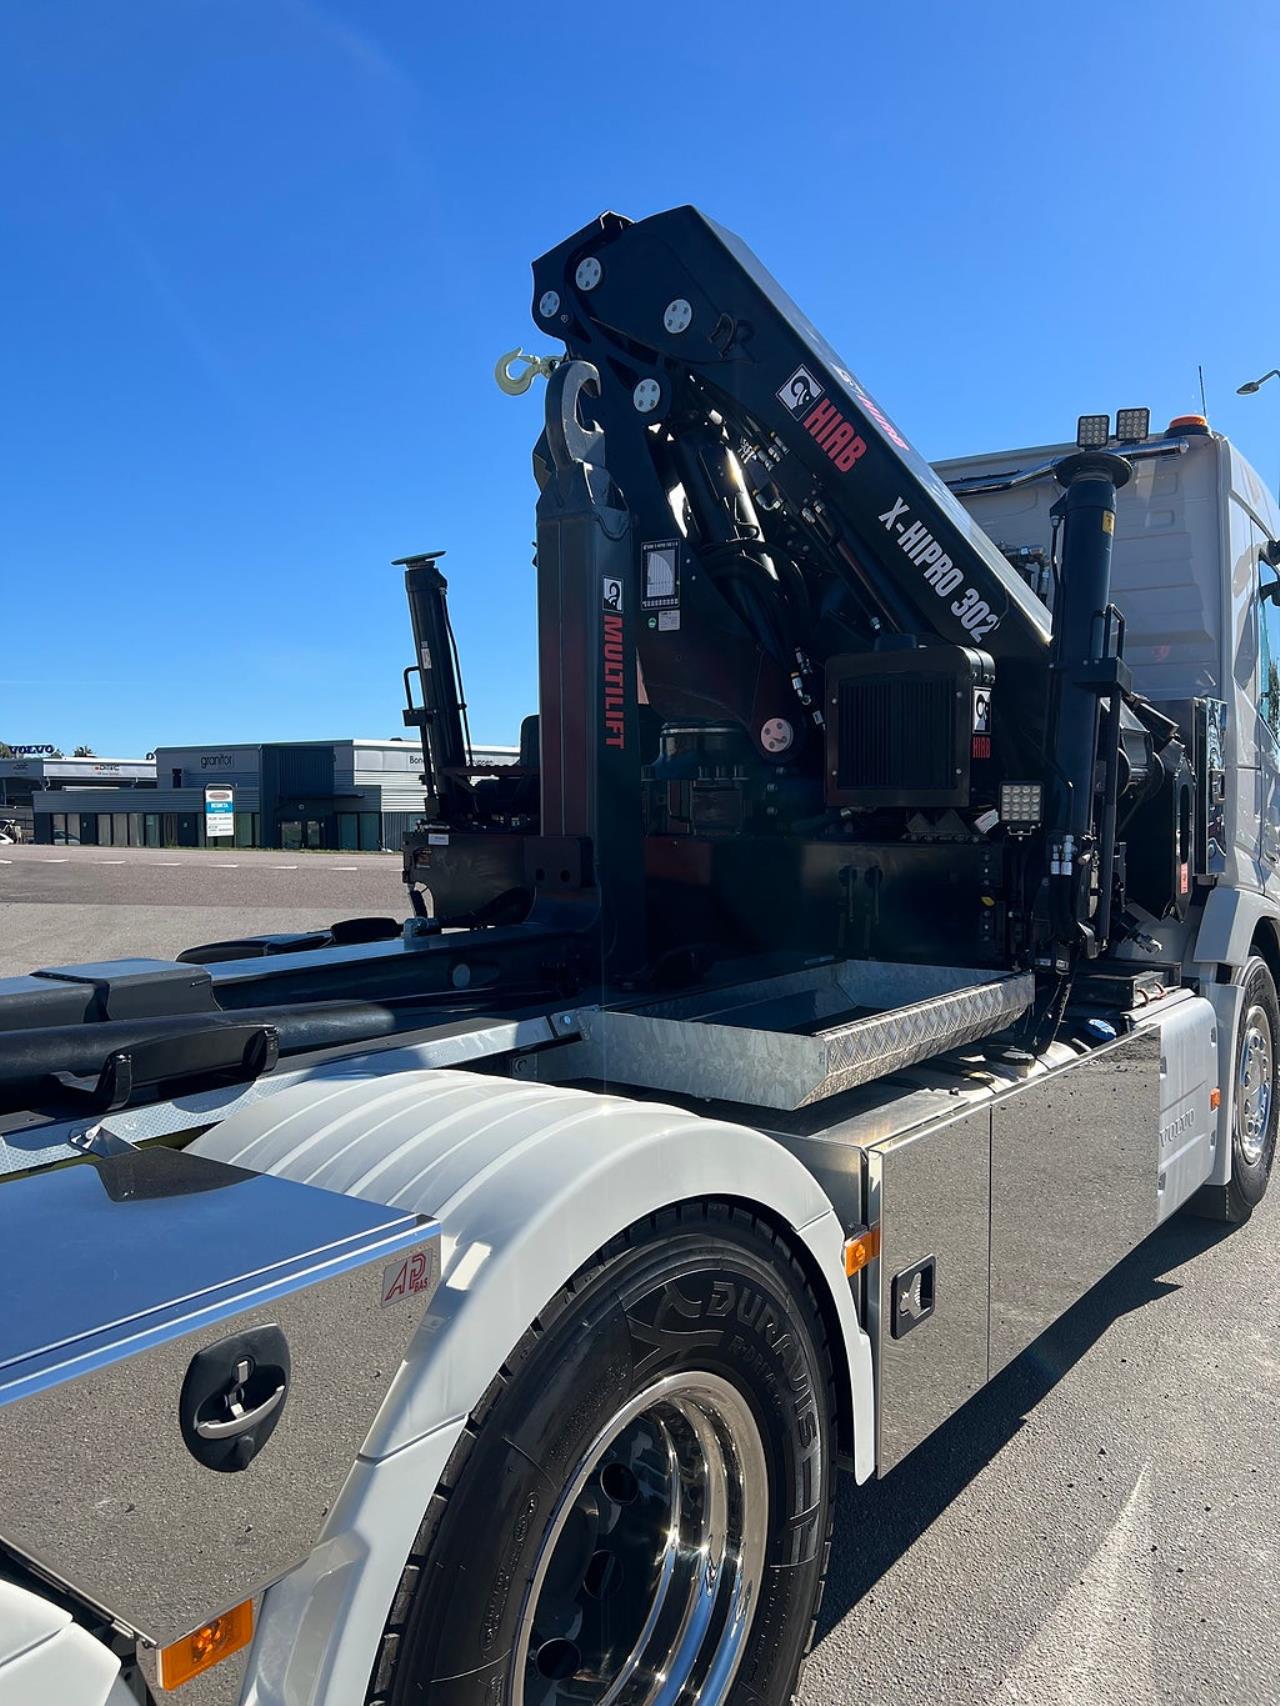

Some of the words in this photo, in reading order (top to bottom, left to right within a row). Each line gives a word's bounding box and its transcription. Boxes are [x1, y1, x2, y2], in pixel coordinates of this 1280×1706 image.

[803, 398, 867, 473] HIAB
[878, 496, 964, 597] X-HIPRO
[950, 588, 999, 643] 302
[603, 615, 625, 750] MULTILIFT
[9, 744, 55, 754] VOLVO
[973, 736, 991, 759] HIAB
[1160, 1108, 1195, 1147] VOLVO
[706, 1280, 818, 1449] DURAVIS
